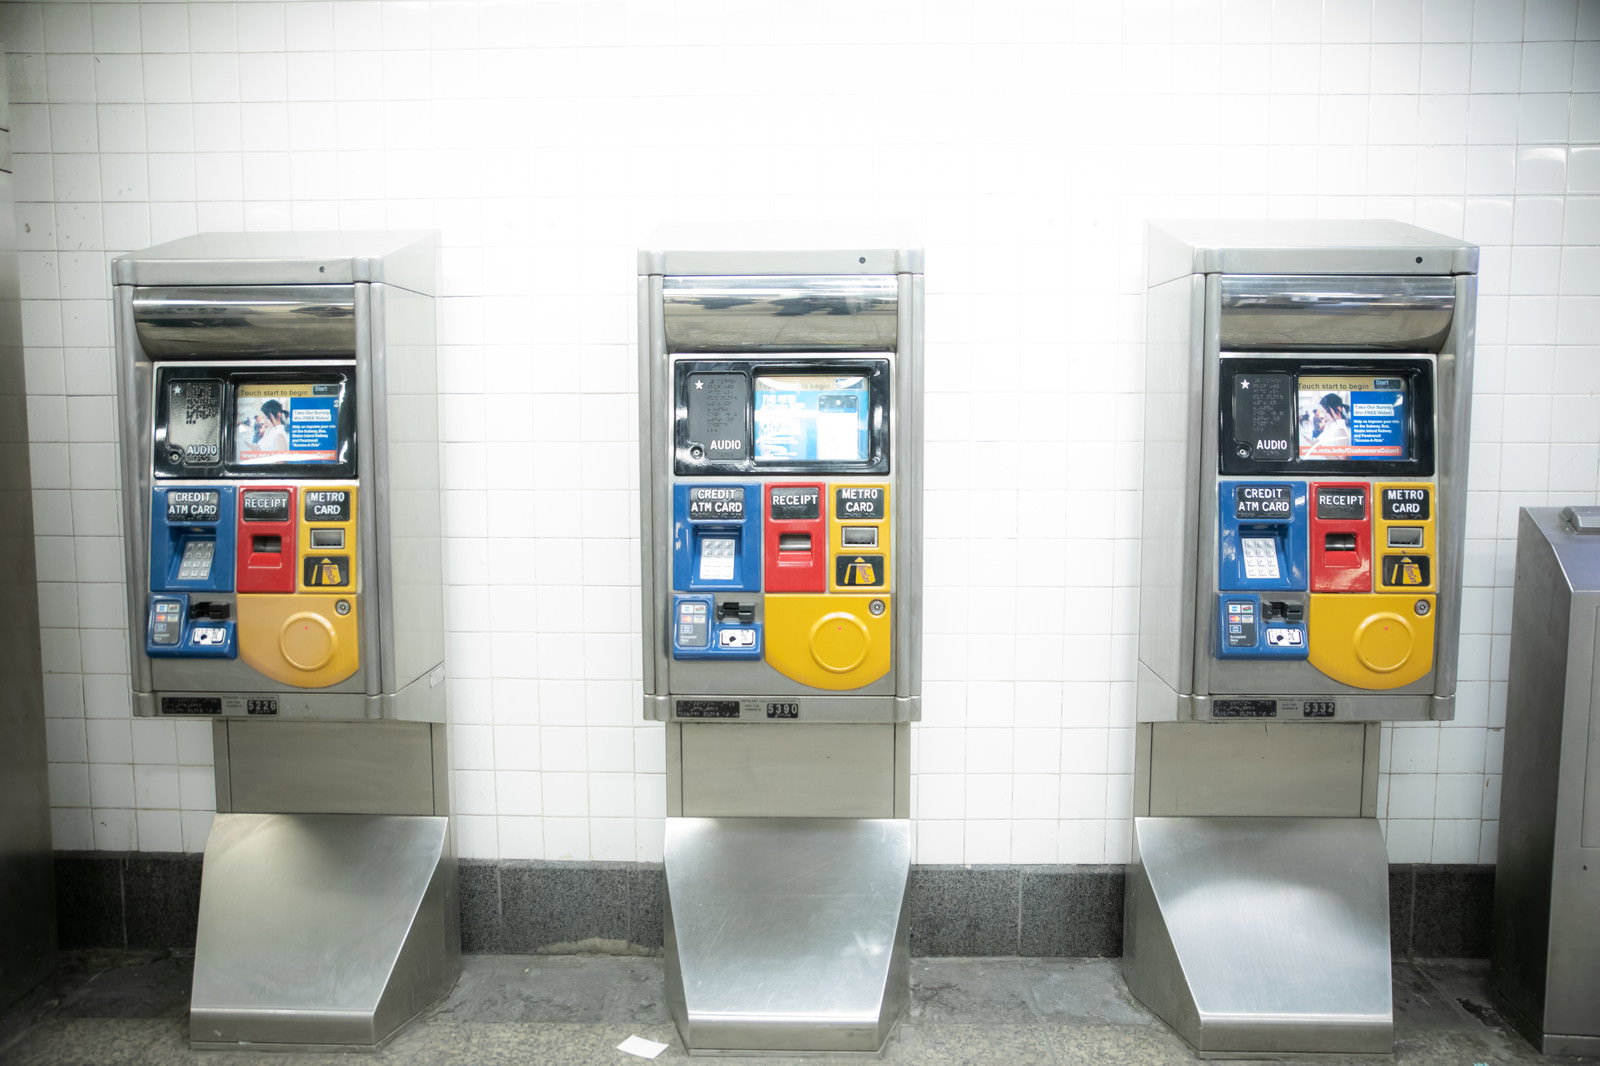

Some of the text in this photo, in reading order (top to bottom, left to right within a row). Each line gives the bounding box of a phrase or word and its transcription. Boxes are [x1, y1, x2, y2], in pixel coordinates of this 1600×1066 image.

[187, 445, 217, 455] AUDIO
[710, 440, 741, 450] AUDIO
[1257, 440, 1287, 450] AUDIO
[176, 492, 211, 502] CREDIT
[310, 492, 345, 502] METRO
[698, 490, 736, 499] CREDIT
[842, 489, 878, 499] METRO
[1245, 489, 1282, 498] CREDIT
[1388, 490, 1424, 500] METRO
[245, 498, 287, 508] RECEIPT
[773, 494, 818, 505] RECEIPT
[1319, 495, 1364, 505] RECEIPT
[168, 504, 217, 514] ATM CARD
[314, 505, 341, 515] CARD
[691, 502, 743, 512] ATM CARD
[846, 502, 873, 512] CARD
[1238, 502, 1289, 512] ATM CARD
[1392, 503, 1420, 513] CARD
[248, 701, 276, 710] 5226
[768, 705, 797, 714] 5390
[1305, 703, 1334, 712] 5332
